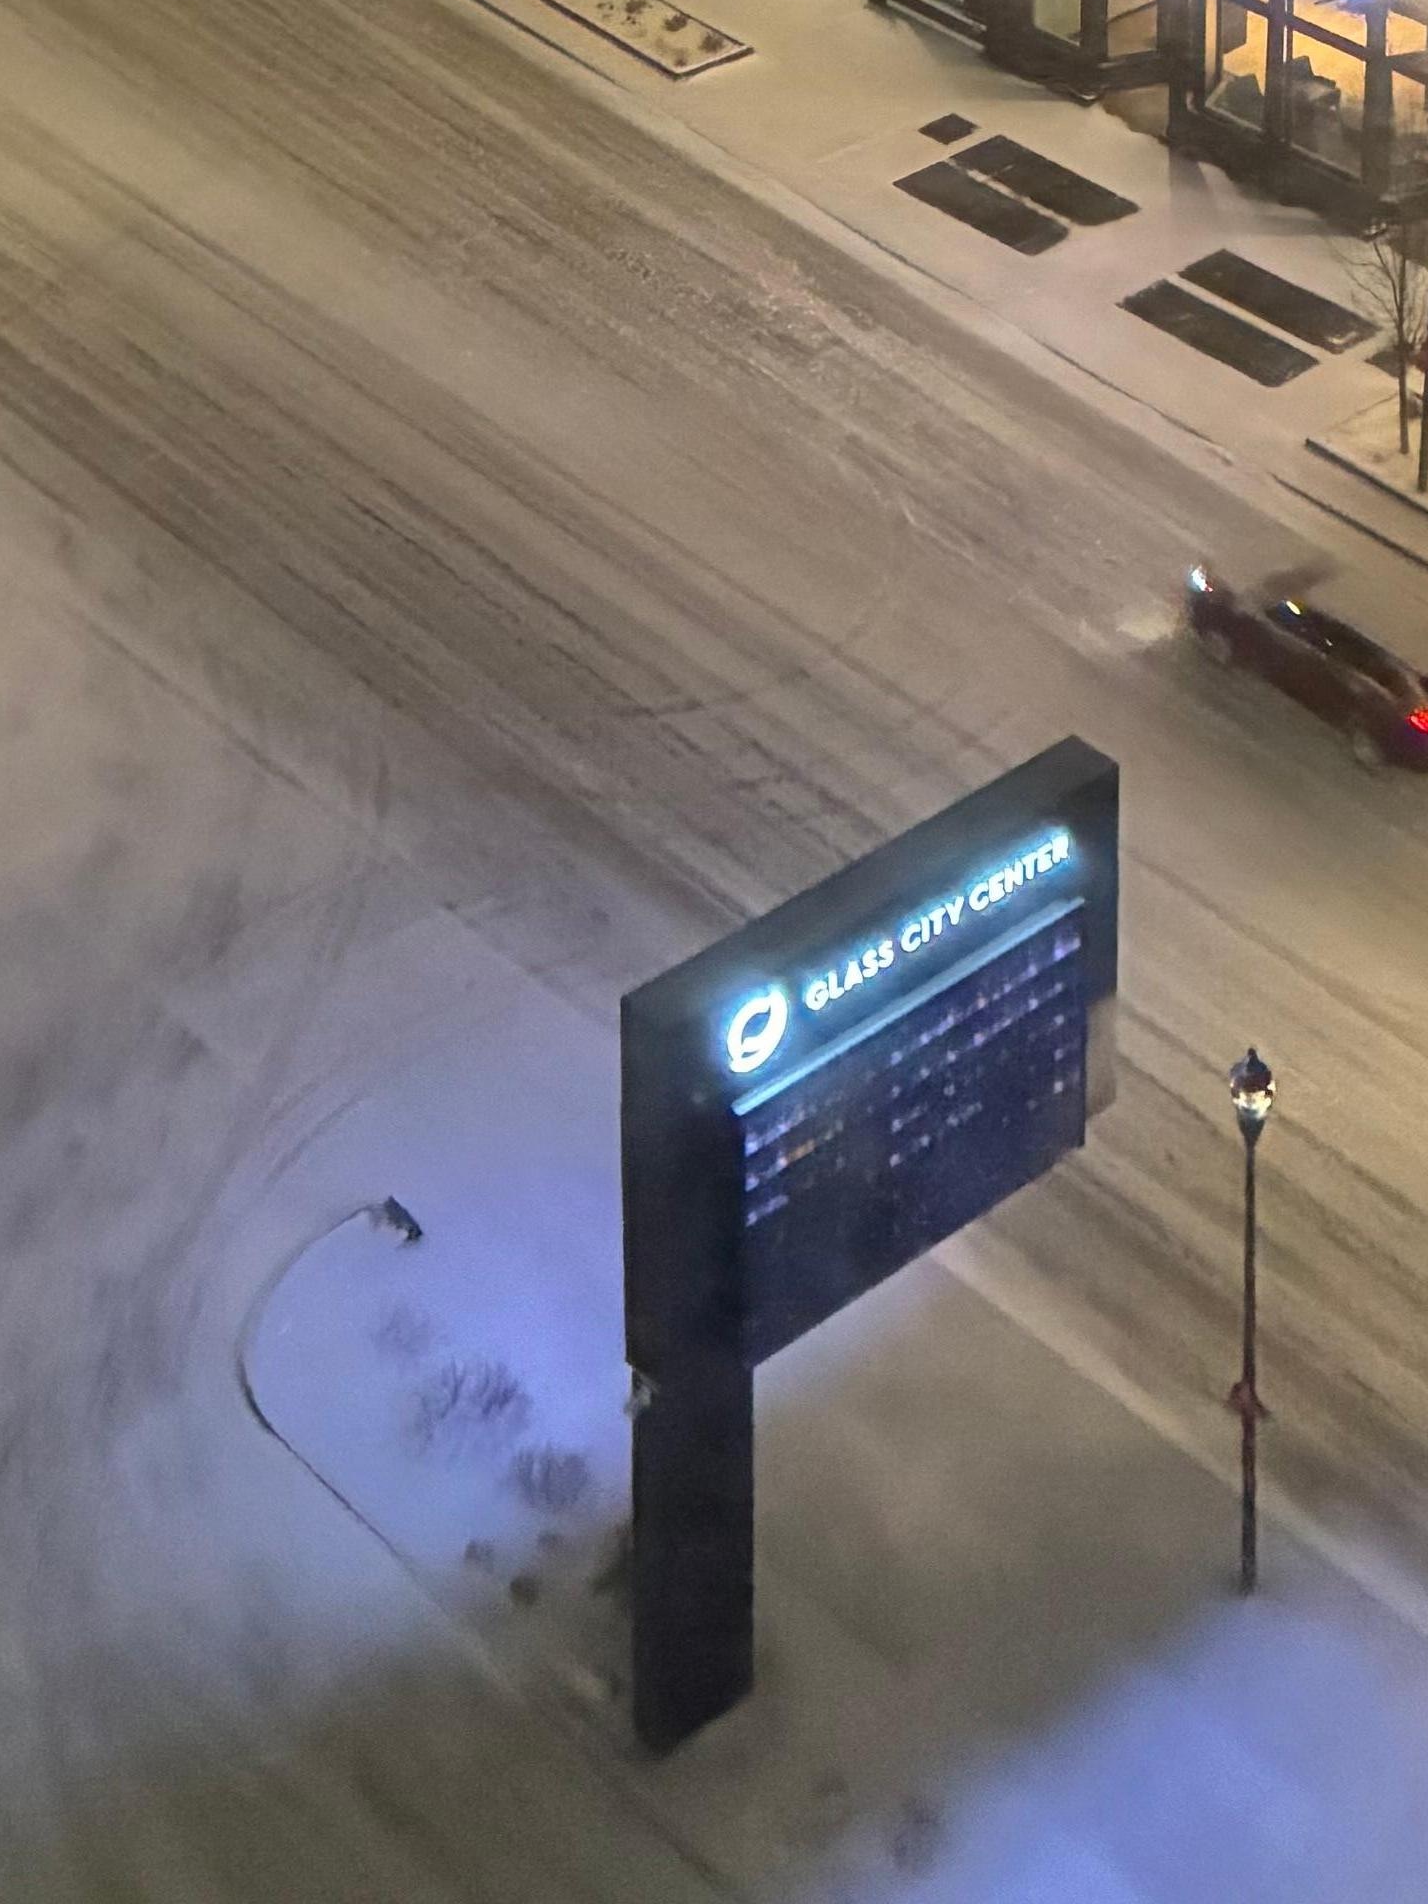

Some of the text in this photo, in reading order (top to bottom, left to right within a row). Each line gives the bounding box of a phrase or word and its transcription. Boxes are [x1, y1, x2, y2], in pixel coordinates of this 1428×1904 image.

[805, 835, 1070, 1011] GLASS CITY CENTER
